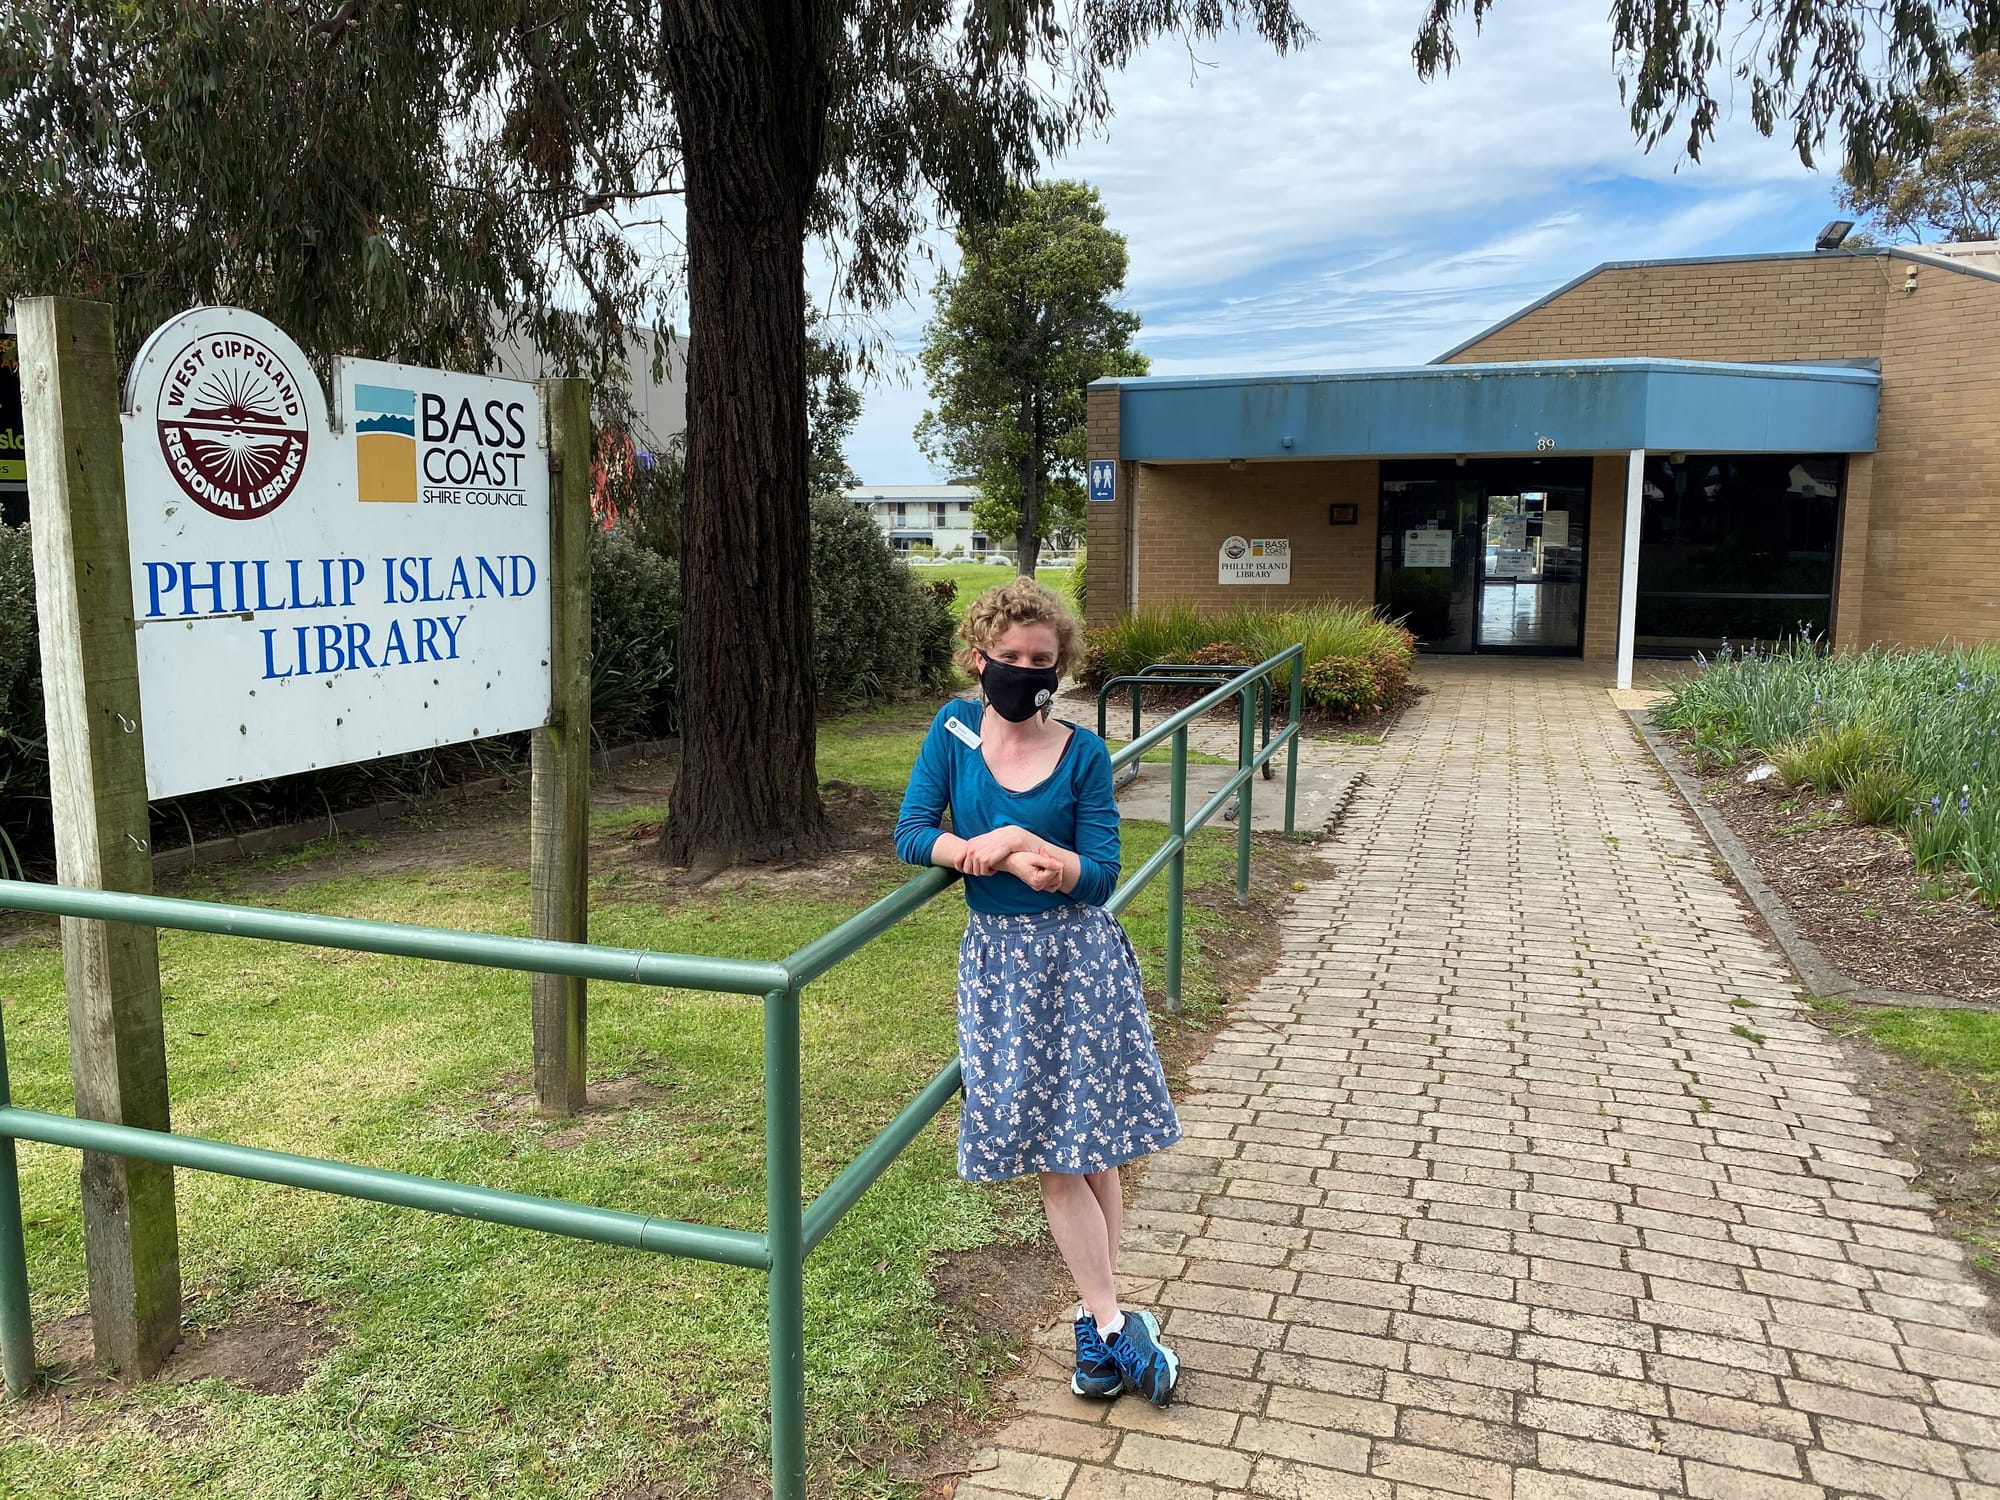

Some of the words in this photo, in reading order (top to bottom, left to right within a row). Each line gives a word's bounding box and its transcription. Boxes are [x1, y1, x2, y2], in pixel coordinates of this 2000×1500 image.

[168, 349, 206, 407] WEST
[211, 341, 299, 417] GIPPSLAND
[422, 392, 526, 449] BASS
[1537, 438, 1555, 451] 89
[164, 427, 245, 511] REGIONAL
[249, 436, 304, 509] LIBRARY
[423, 447, 526, 487] COAST
[423, 489, 462, 504] SHIRE
[465, 491, 527, 507] COUNCIL
[1265, 540, 1287, 548] BASS
[142, 558, 366, 618] PHILLIP
[382, 554, 537, 604] ISLAND
[1221, 562, 1254, 570] PHILLIP
[1256, 562, 1288, 570] ISLAND
[1236, 570, 1272, 578] LIBRARY
[259, 615, 467, 680] LIBRARY
